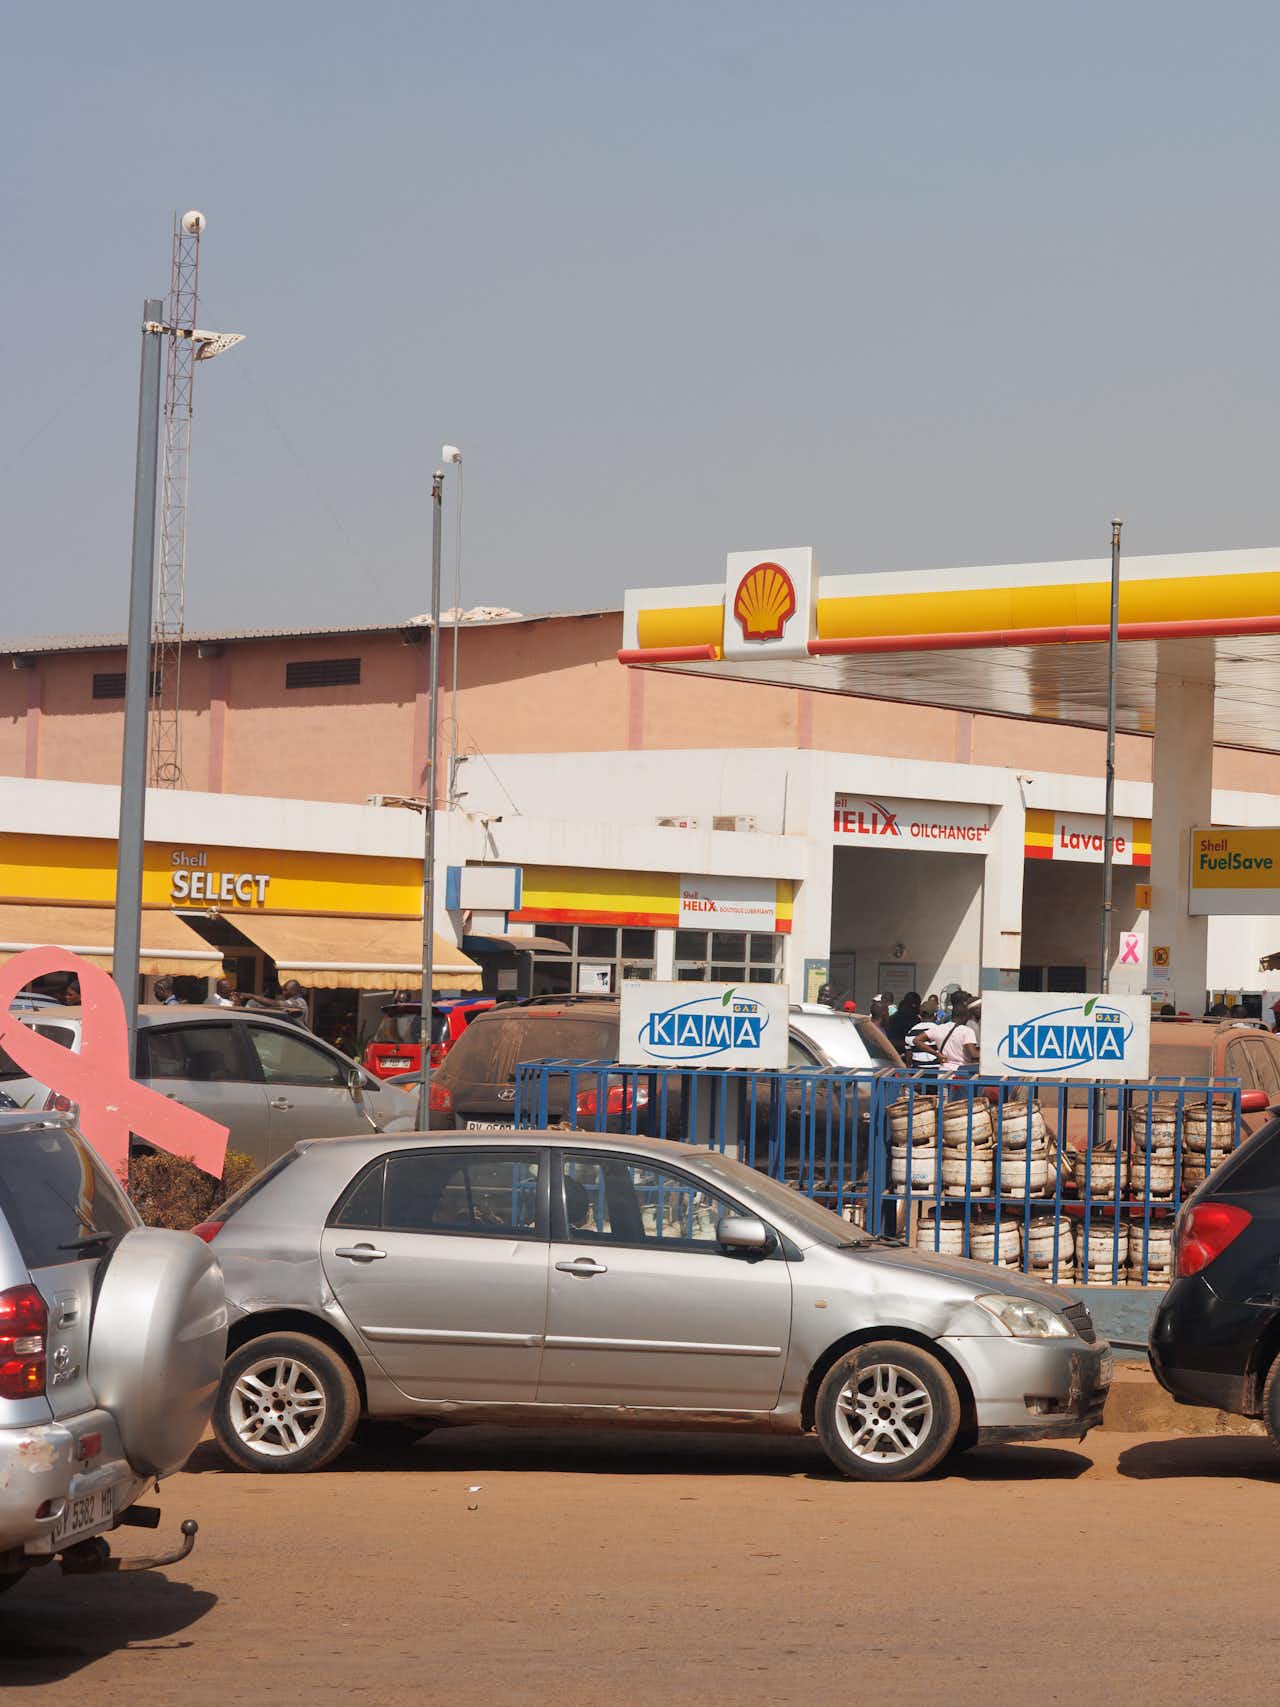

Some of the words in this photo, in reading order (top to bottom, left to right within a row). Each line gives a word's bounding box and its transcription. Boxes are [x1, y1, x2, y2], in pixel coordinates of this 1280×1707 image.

[834, 799, 849, 808] ell
[1060, 825, 1126, 856] Lavae
[1200, 839, 1228, 852] Shell
[172, 851, 207, 867] Shell
[1199, 852, 1273, 870] FuelSave
[172, 870, 270, 902] SELECT
[683, 900, 717, 912] HELIX
[733, 1004, 758, 1014] GAZ
[1096, 1014, 1120, 1023] GAZ
[653, 1014, 758, 1047] KAMA
[1012, 1027, 1122, 1058] KAMA
[72, 1495, 95, 1531] 5382
